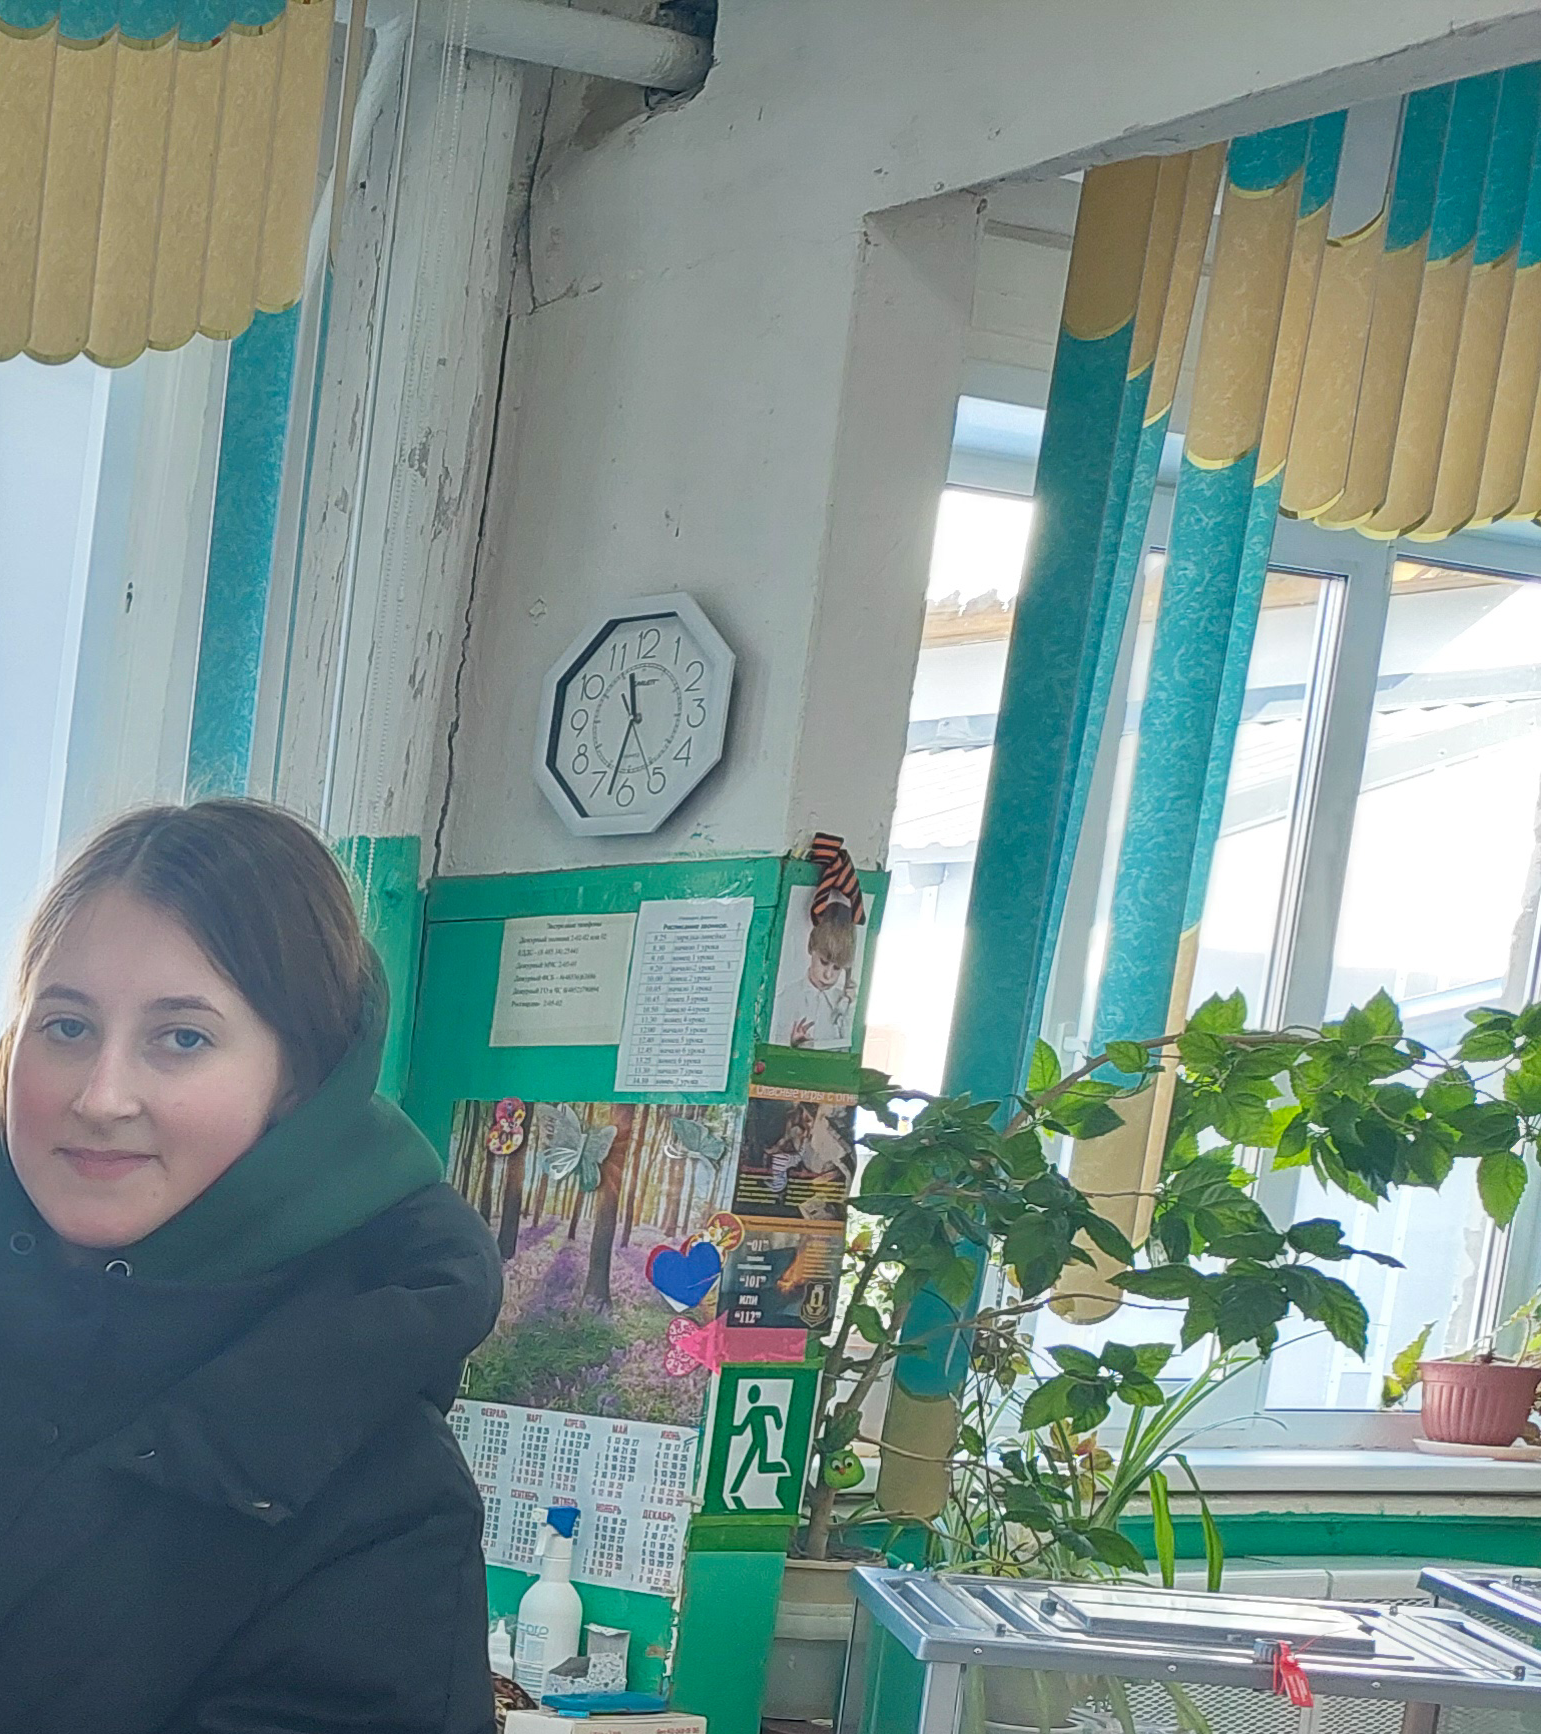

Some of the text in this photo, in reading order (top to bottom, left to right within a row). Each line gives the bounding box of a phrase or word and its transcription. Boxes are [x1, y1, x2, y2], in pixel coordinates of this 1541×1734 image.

[610, 643, 627, 672] 11
[637, 628, 661, 659] 12
[674, 636, 682, 665] 1
[580, 673, 605, 701] 10
[685, 660, 704, 692] 2
[570, 709, 589, 738] 9
[687, 698, 706, 728] 3
[572, 744, 589, 775] 8
[673, 736, 692, 767] 4
[589, 771, 608, 798] 7
[615, 777, 635, 807] 6
[647, 767, 666, 794] 5
[460, 1358, 471, 1394] 4
[642, 1509, 676, 1522] ДЕКАБРЬ
